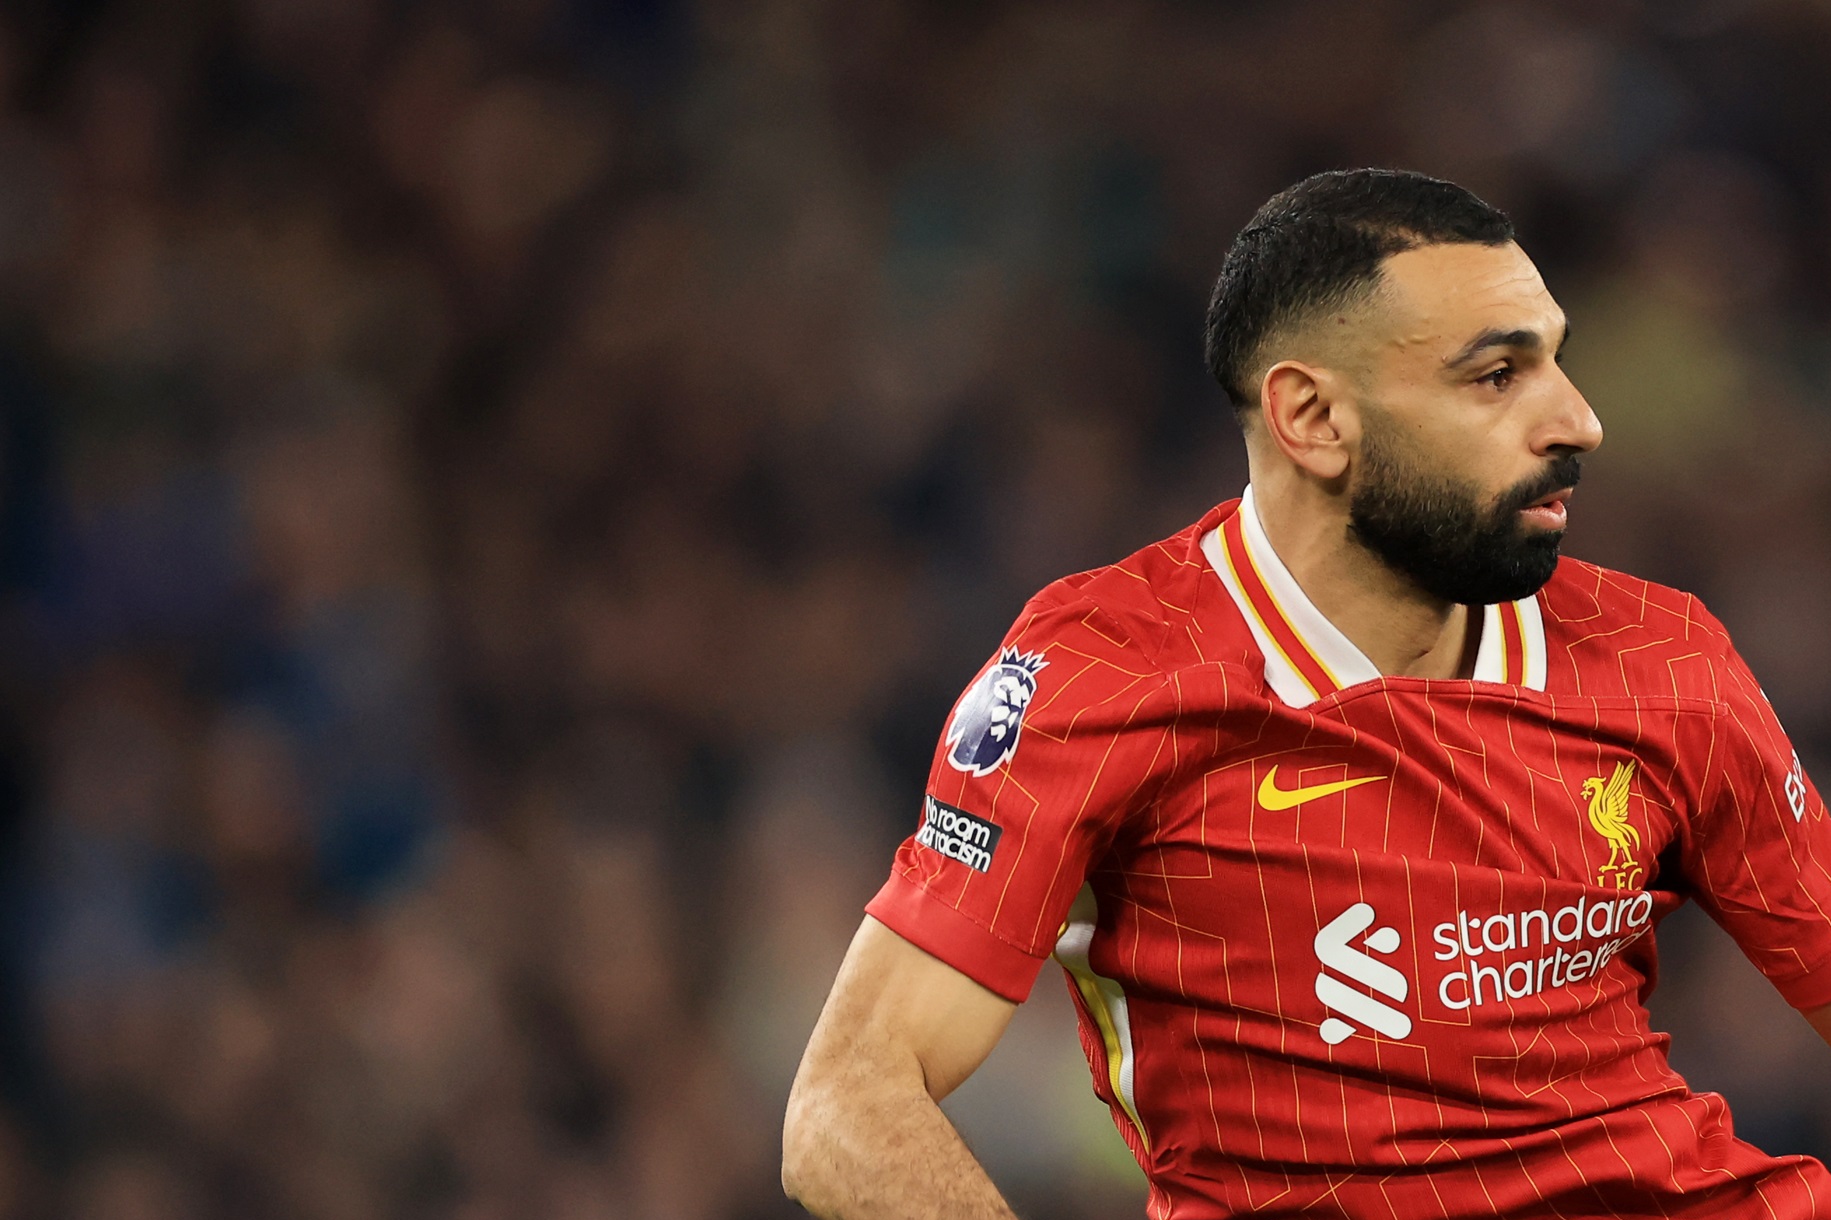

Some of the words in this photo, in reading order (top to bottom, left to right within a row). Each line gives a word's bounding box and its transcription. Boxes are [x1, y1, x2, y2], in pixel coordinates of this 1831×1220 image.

[926, 795, 938, 825] No
[937, 808, 991, 848] room
[934, 830, 991, 873] racism
